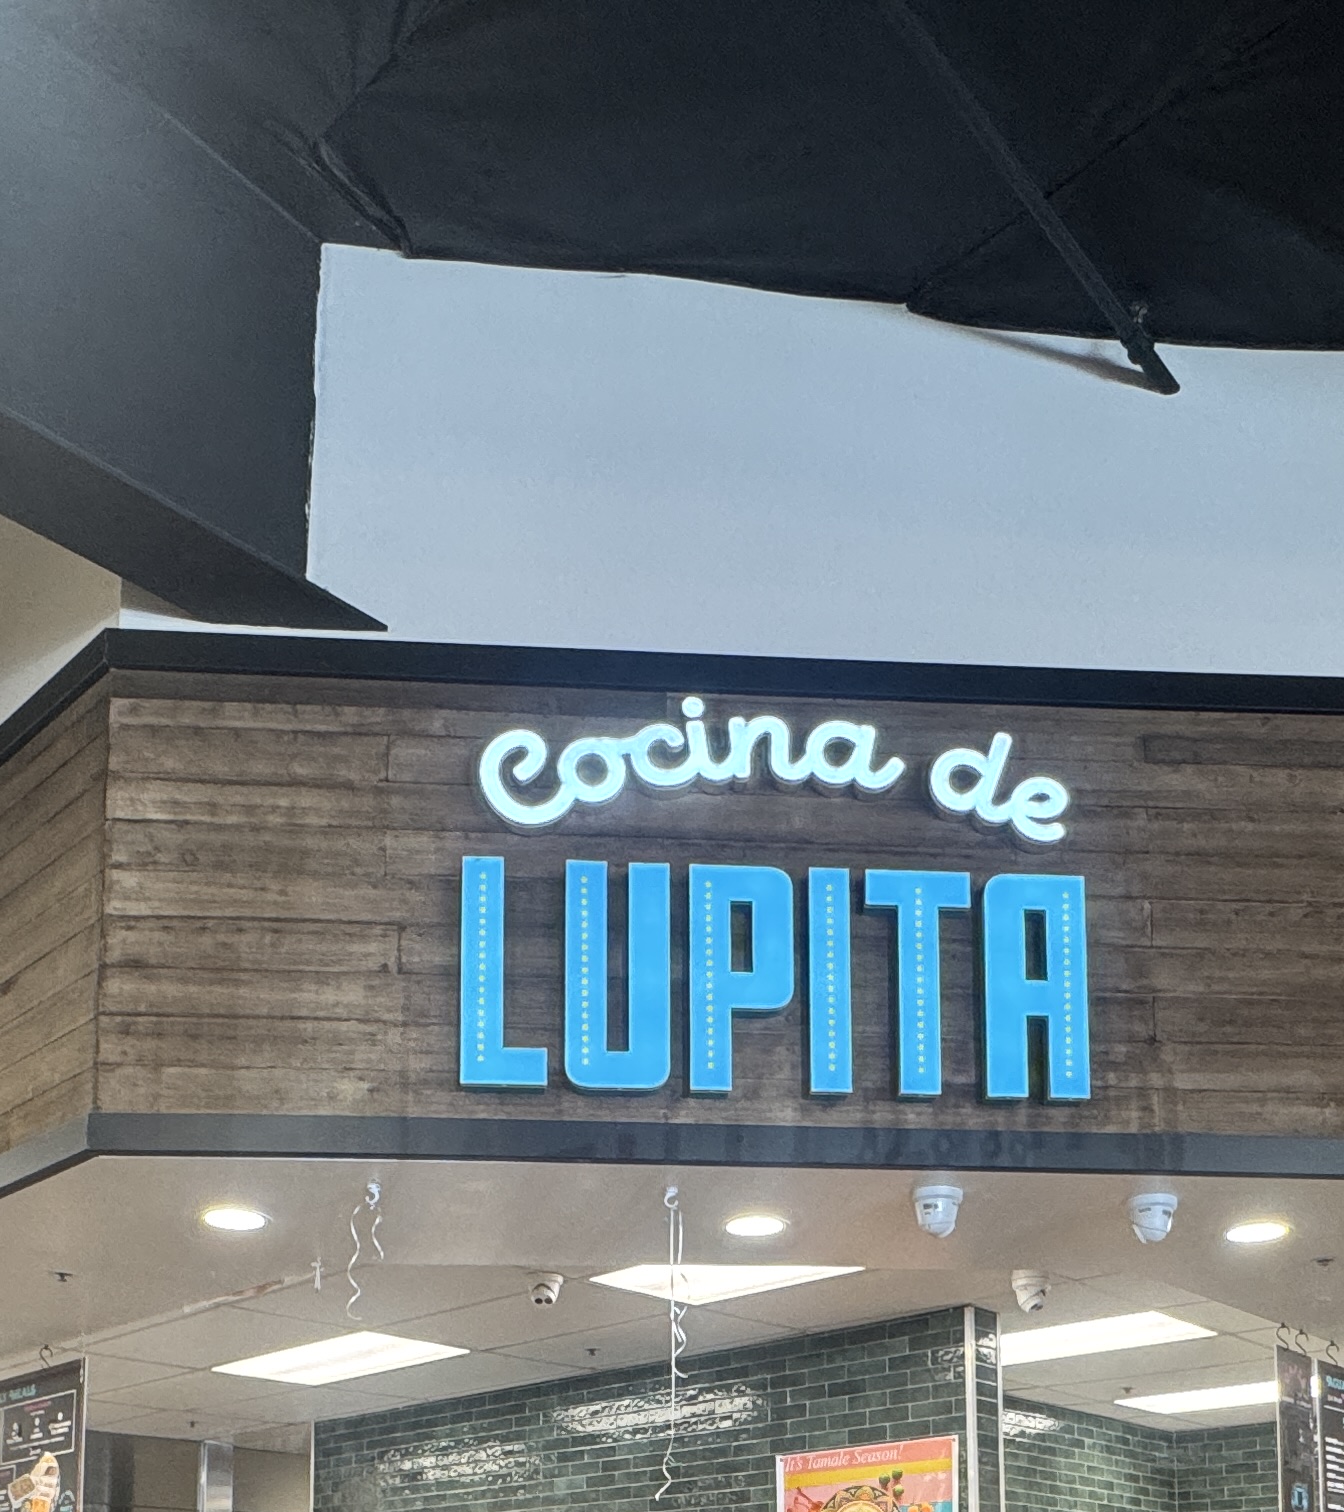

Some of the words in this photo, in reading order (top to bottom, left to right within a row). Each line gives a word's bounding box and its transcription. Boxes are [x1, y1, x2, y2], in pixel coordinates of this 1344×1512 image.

[479, 696, 906, 829] Cocina
[929, 731, 1069, 842] de
[459, 855, 1091, 1100] LUPITA
[785, 1457, 803, 1472] It's
[807, 1451, 849, 1470] Tamale
[853, 1444, 904, 1465] Season!
